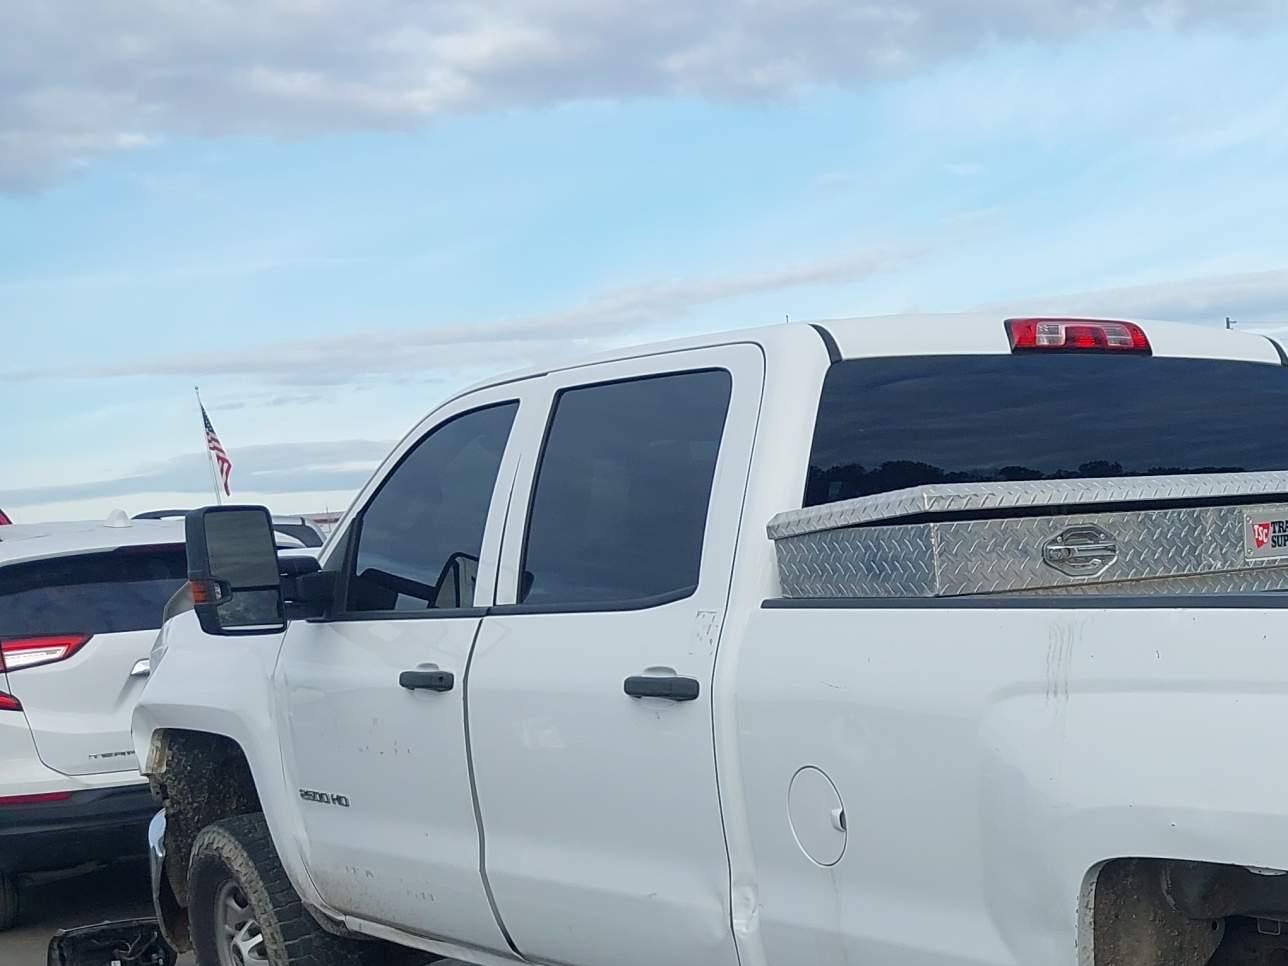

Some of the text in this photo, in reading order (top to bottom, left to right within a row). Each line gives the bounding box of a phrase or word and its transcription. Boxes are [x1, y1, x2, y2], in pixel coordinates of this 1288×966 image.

[1254, 524, 1269, 543] TSC
[299, 789, 350, 807] 2500 HD
